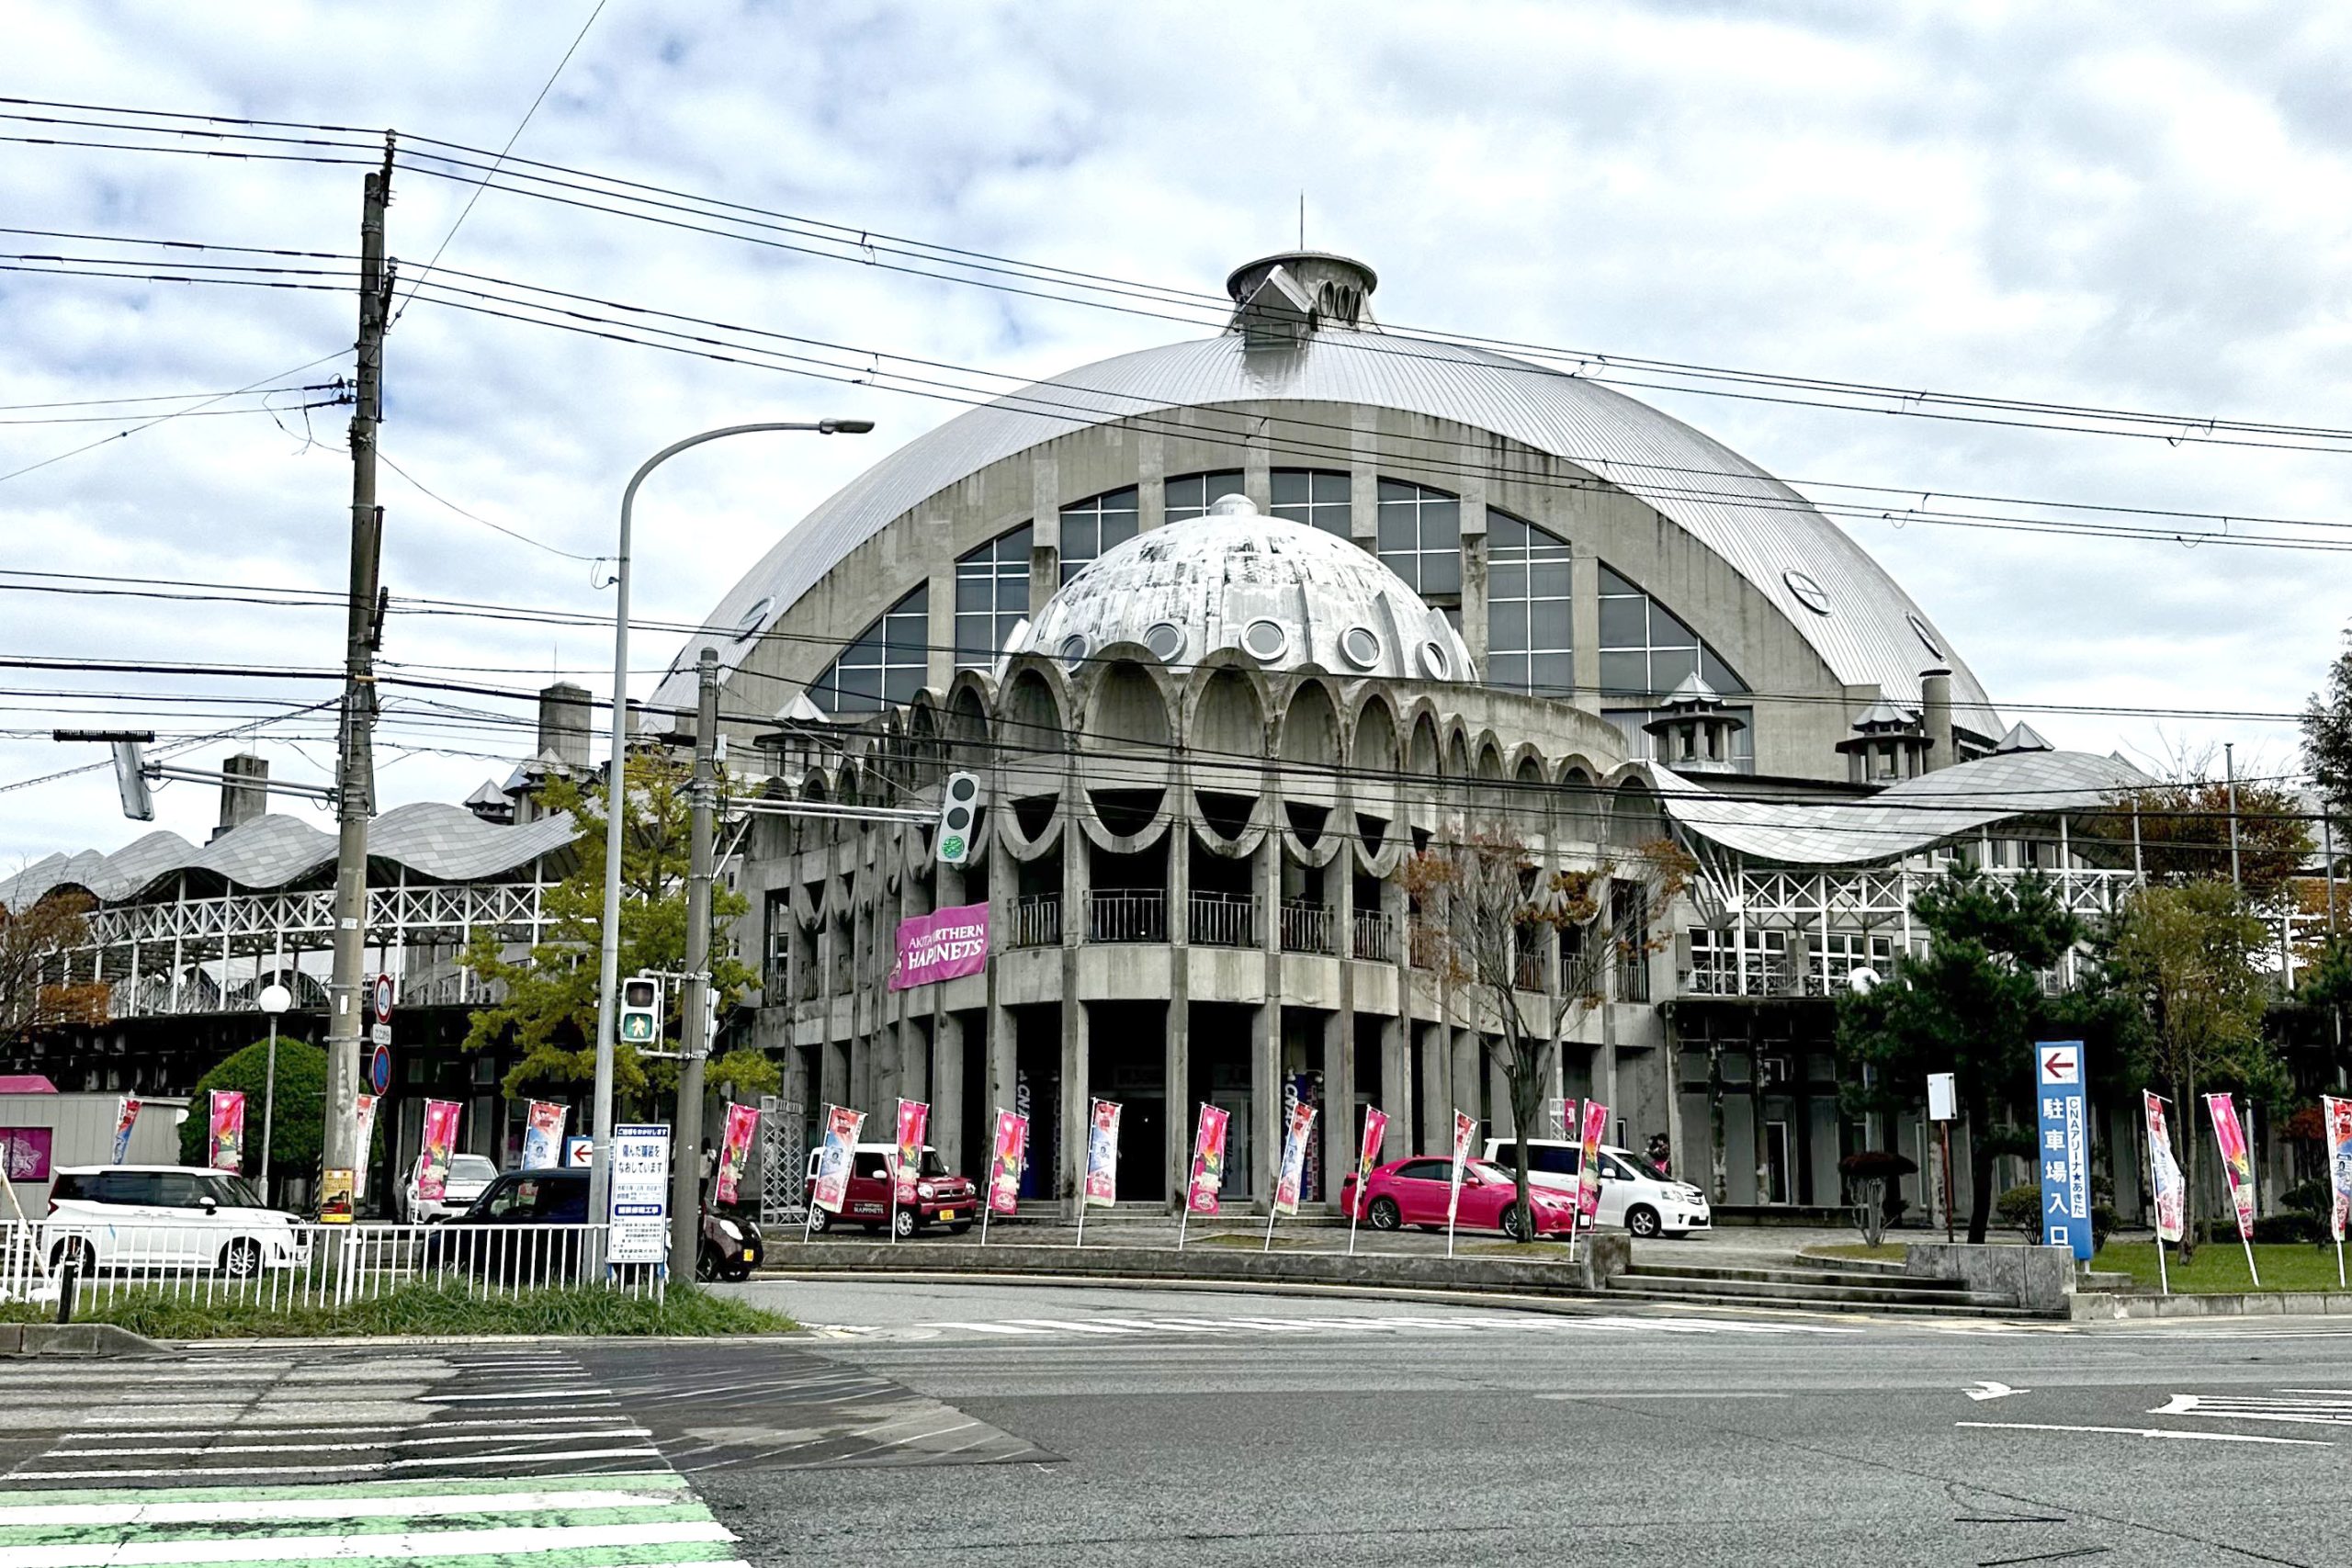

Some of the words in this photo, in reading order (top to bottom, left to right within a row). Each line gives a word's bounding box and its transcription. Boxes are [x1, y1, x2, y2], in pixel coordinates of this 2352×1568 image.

[933, 923, 984, 942] RTHERN
[908, 939, 984, 970] HAPNETS
[379, 987, 389, 1010] 40
[618, 1162, 662, 1174] なおしています
[2069, 1099, 2084, 1214] CNAアリーナ★あきた
[2042, 1098, 2068, 1246] 駐車場入口
